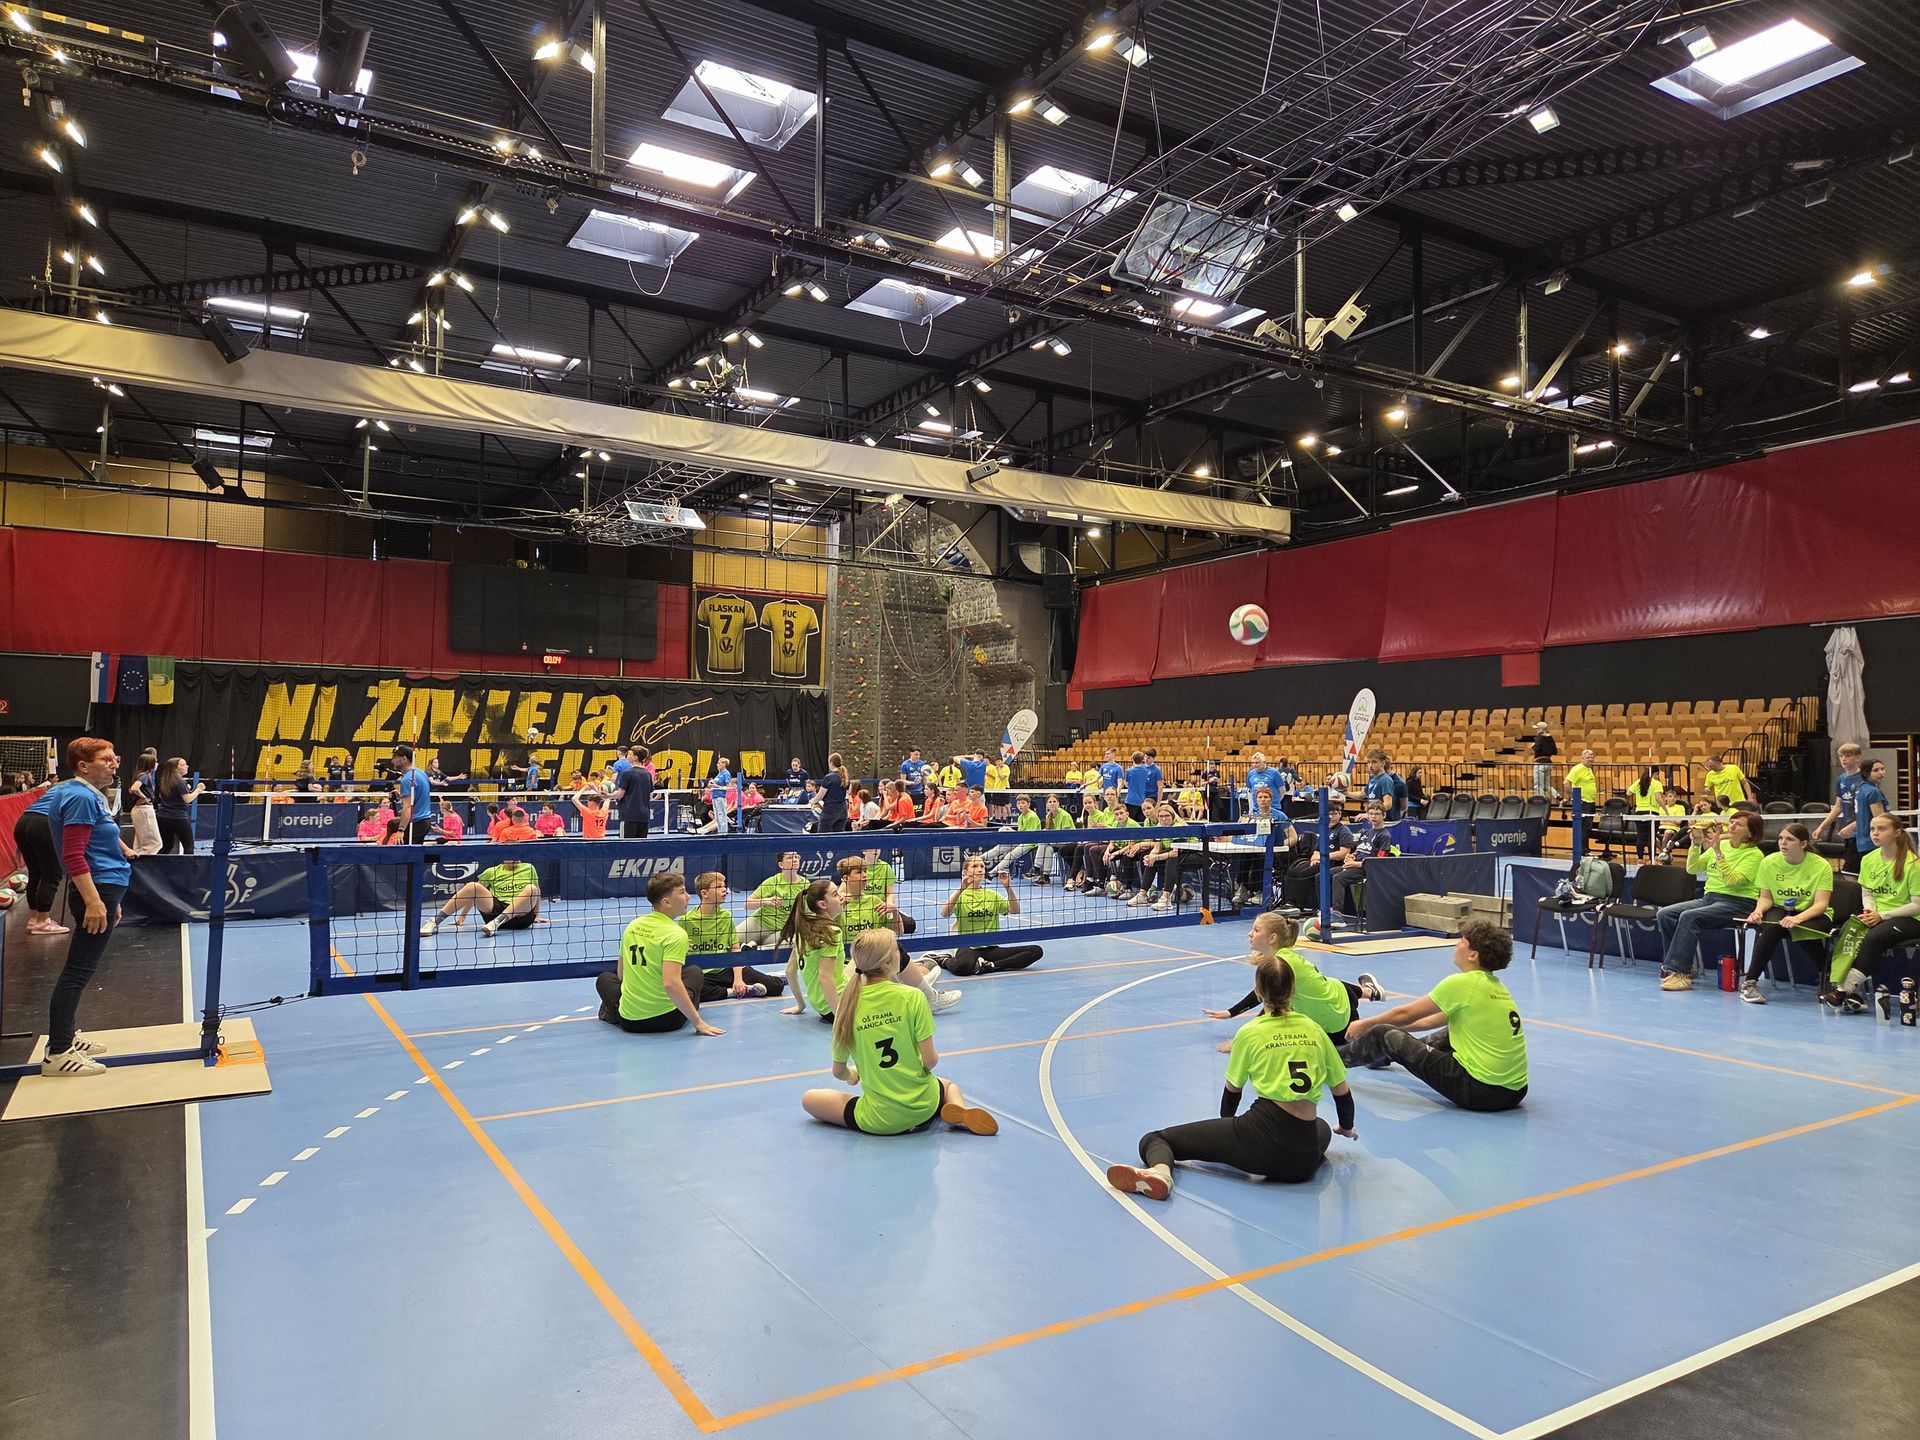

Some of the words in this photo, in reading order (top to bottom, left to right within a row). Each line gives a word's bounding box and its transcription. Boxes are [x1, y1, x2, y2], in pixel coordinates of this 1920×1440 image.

[719, 614, 733, 635] 7
[783, 619, 795, 639] 3
[255, 681, 338, 742] NI
[278, 812, 334, 829] orenje
[595, 819, 605, 827] 12
[1490, 829, 1527, 848] gorenje
[608, 855, 685, 879] EKIPA
[1776, 886, 1812, 898] odbito
[691, 938, 724, 952] odbito
[629, 944, 648, 967] 11
[862, 1014, 871, 1023] OŠ
[872, 1011, 893, 1021] FRANA
[885, 1015, 903, 1025] CELJE
[1508, 1010, 1521, 1036] 9
[1265, 1040, 1297, 1050] KRANJCA
[1273, 1032, 1283, 1041] OŠ
[875, 1036, 899, 1069] 3
[1287, 1061, 1312, 1094] 5
